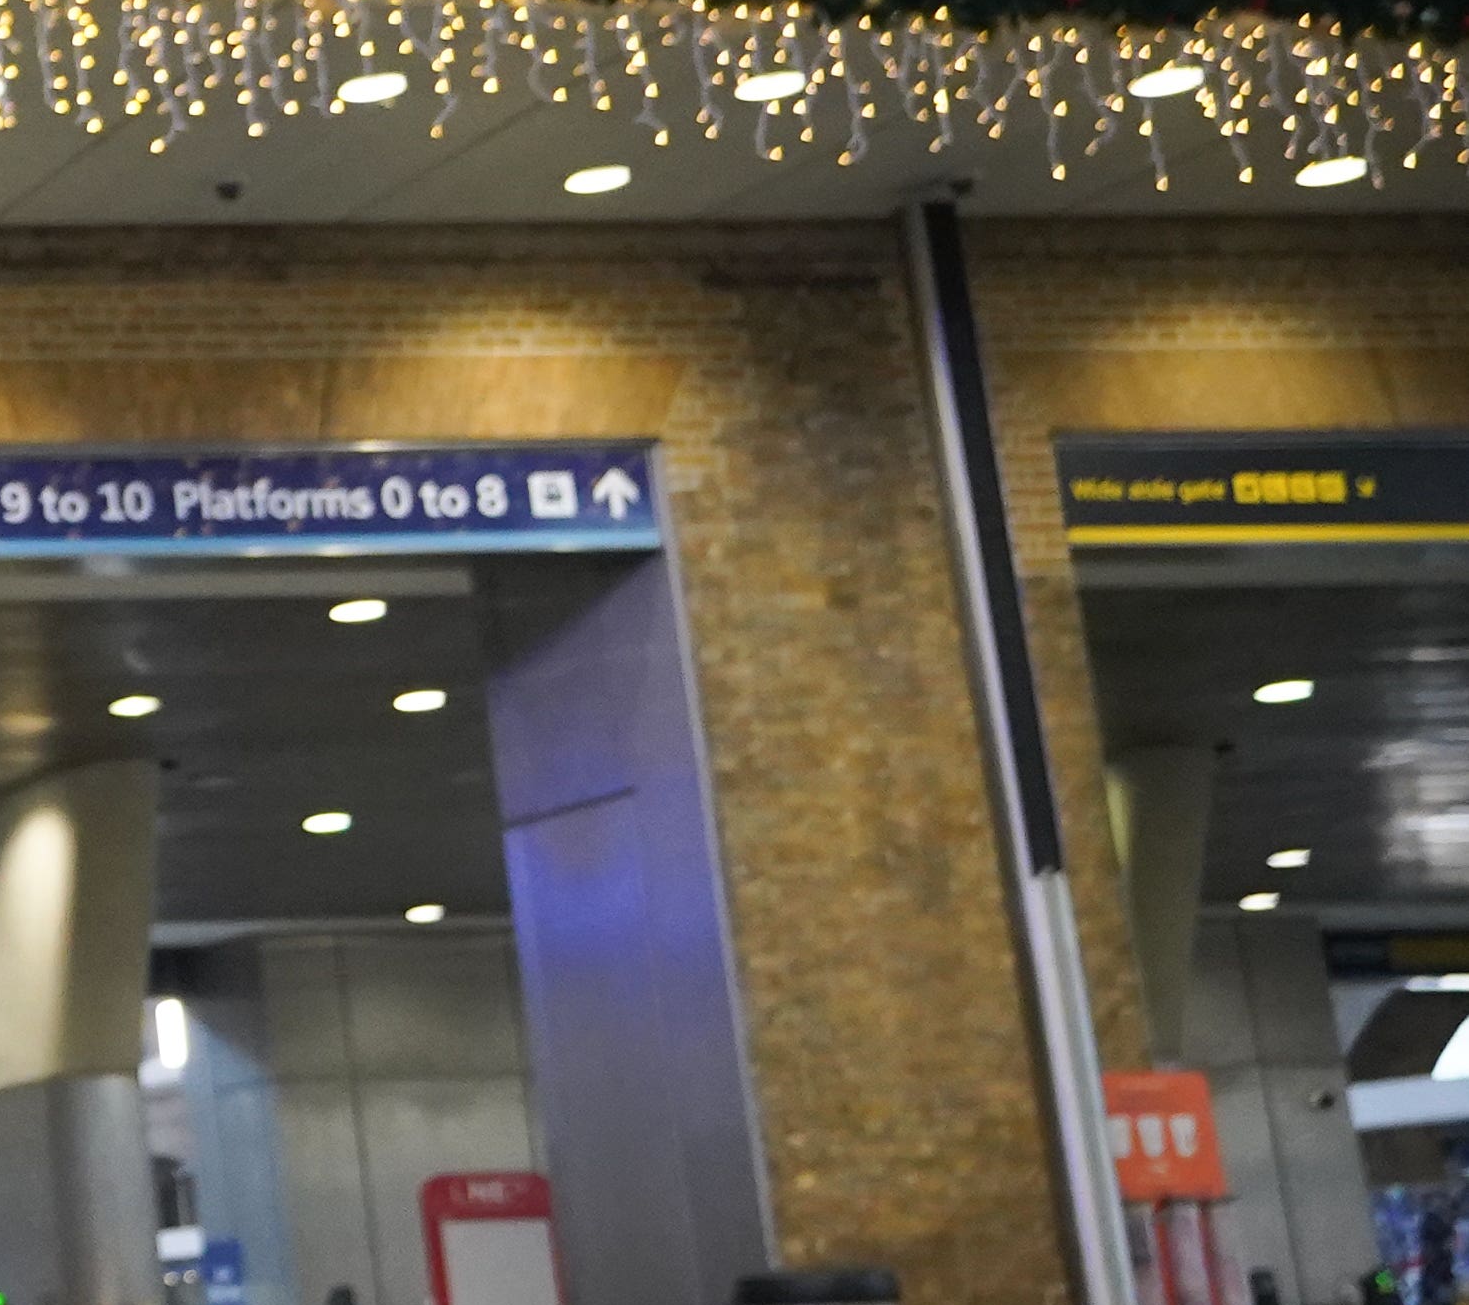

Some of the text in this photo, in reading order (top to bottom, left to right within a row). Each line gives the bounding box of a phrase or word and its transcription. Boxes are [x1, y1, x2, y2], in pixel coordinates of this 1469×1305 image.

[0, 482, 31, 523] 9
[40, 486, 89, 523] to
[99, 482, 152, 522] 10
[173, 479, 371, 521] Platforms
[380, 477, 412, 519] 0
[419, 480, 470, 518] to
[477, 475, 508, 517] 8
